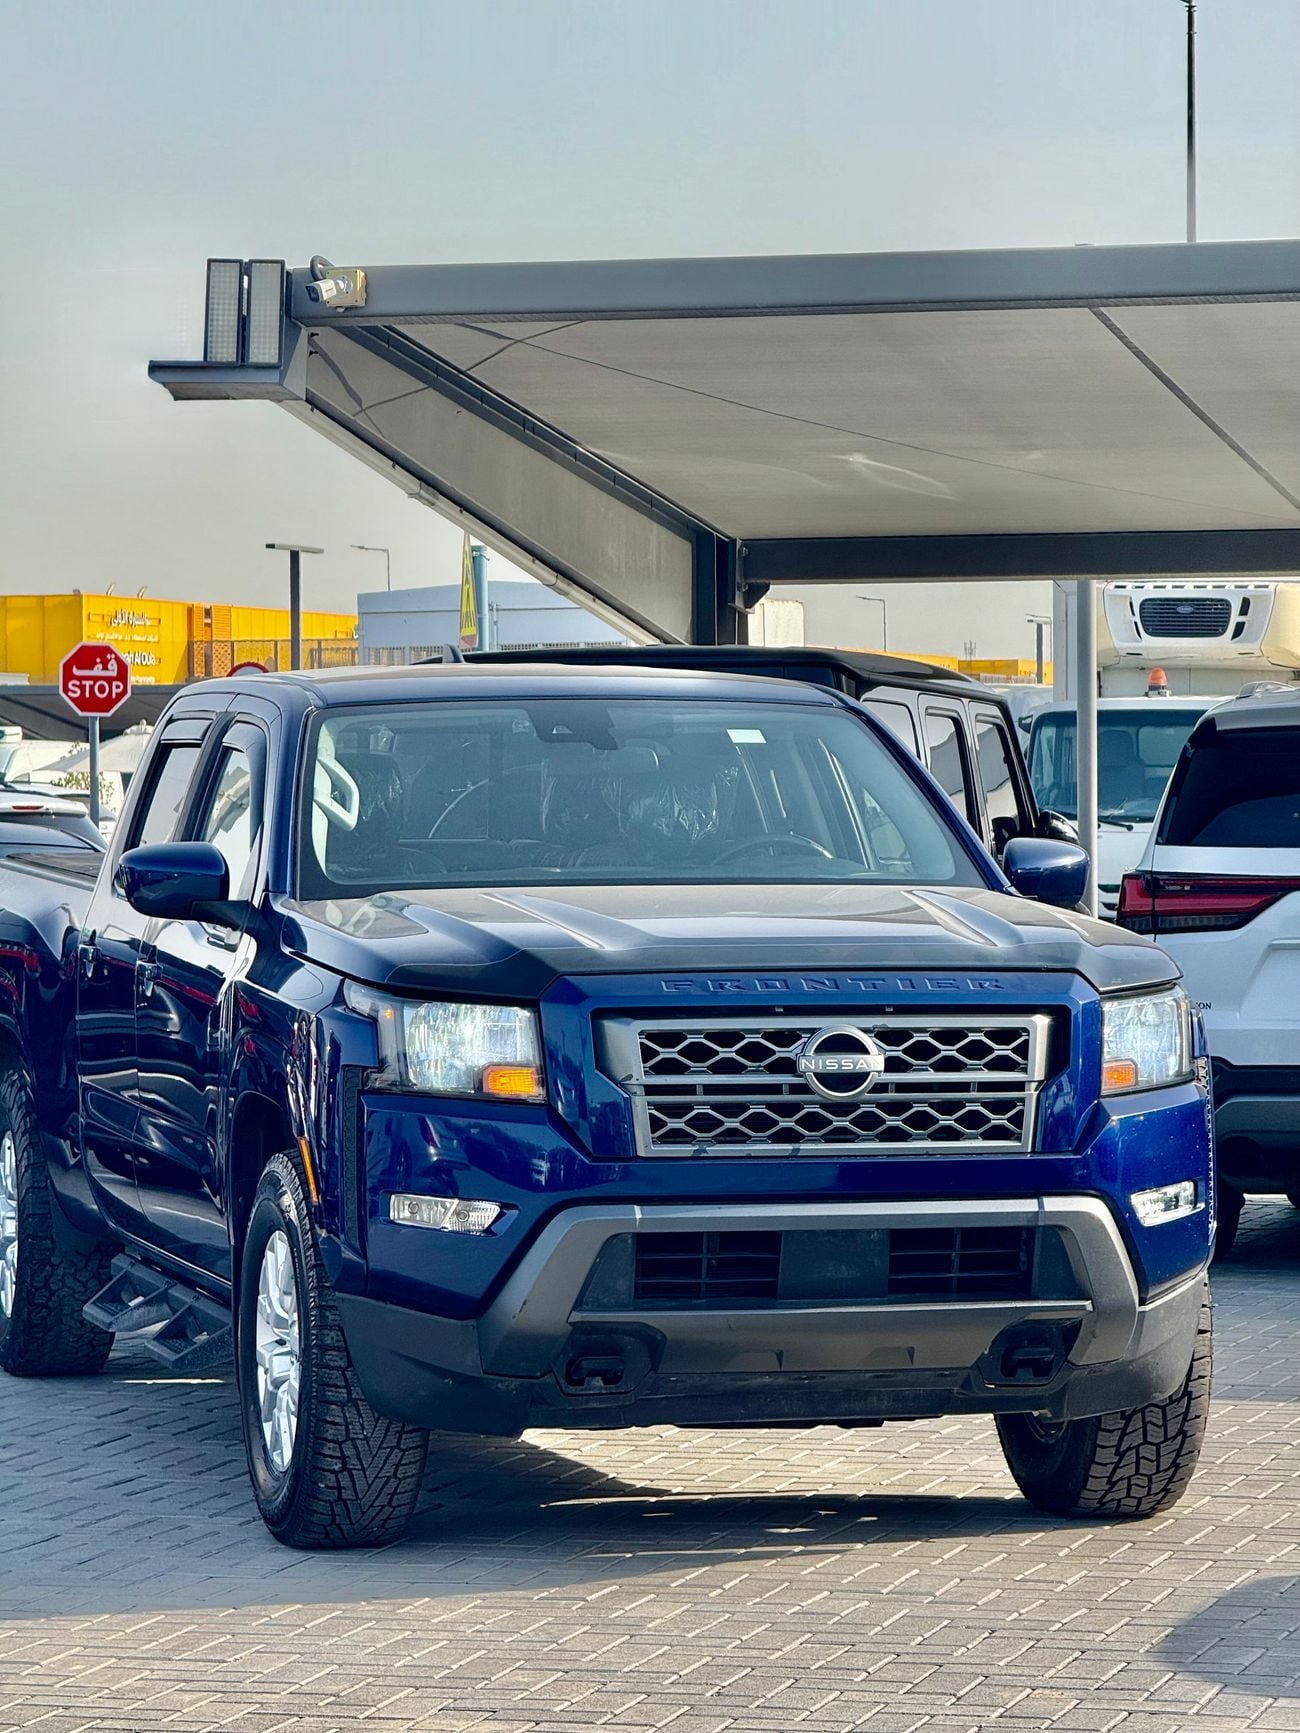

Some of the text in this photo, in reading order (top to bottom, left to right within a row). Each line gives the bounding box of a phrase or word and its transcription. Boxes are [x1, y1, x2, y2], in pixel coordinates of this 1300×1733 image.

[72, 653, 118, 677] قف
[67, 679, 124, 699] STOP
[660, 977, 1006, 993] FRONTIER
[800, 1059, 883, 1070] NISSAN
